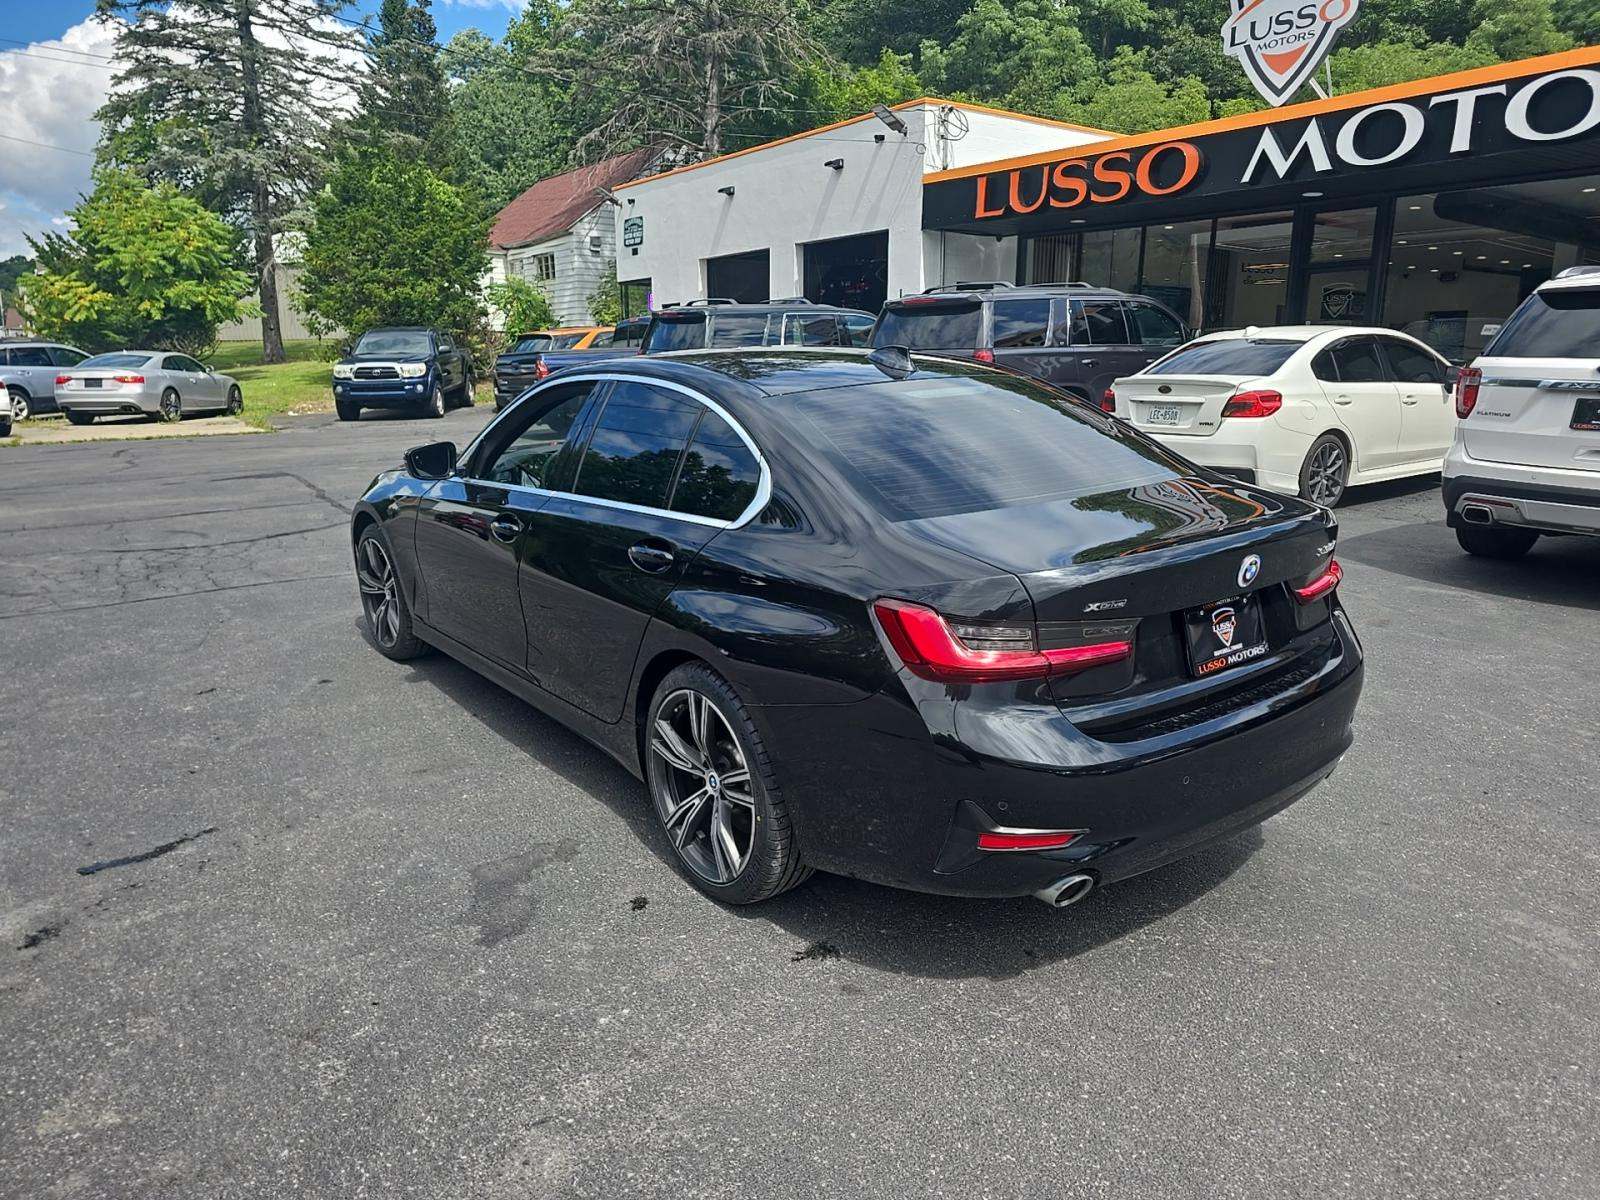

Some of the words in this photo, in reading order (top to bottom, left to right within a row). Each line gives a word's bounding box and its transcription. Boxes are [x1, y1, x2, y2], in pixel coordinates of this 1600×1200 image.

[1230, 0, 1351, 48] LUSSO
[1255, 29, 1315, 52] MOTORS
[975, 141, 1199, 219] LUSSO
[1240, 69, 1600, 183] MOTO
[1198, 657, 1227, 674] LUSSO
[1228, 644, 1265, 664] MOTORS
